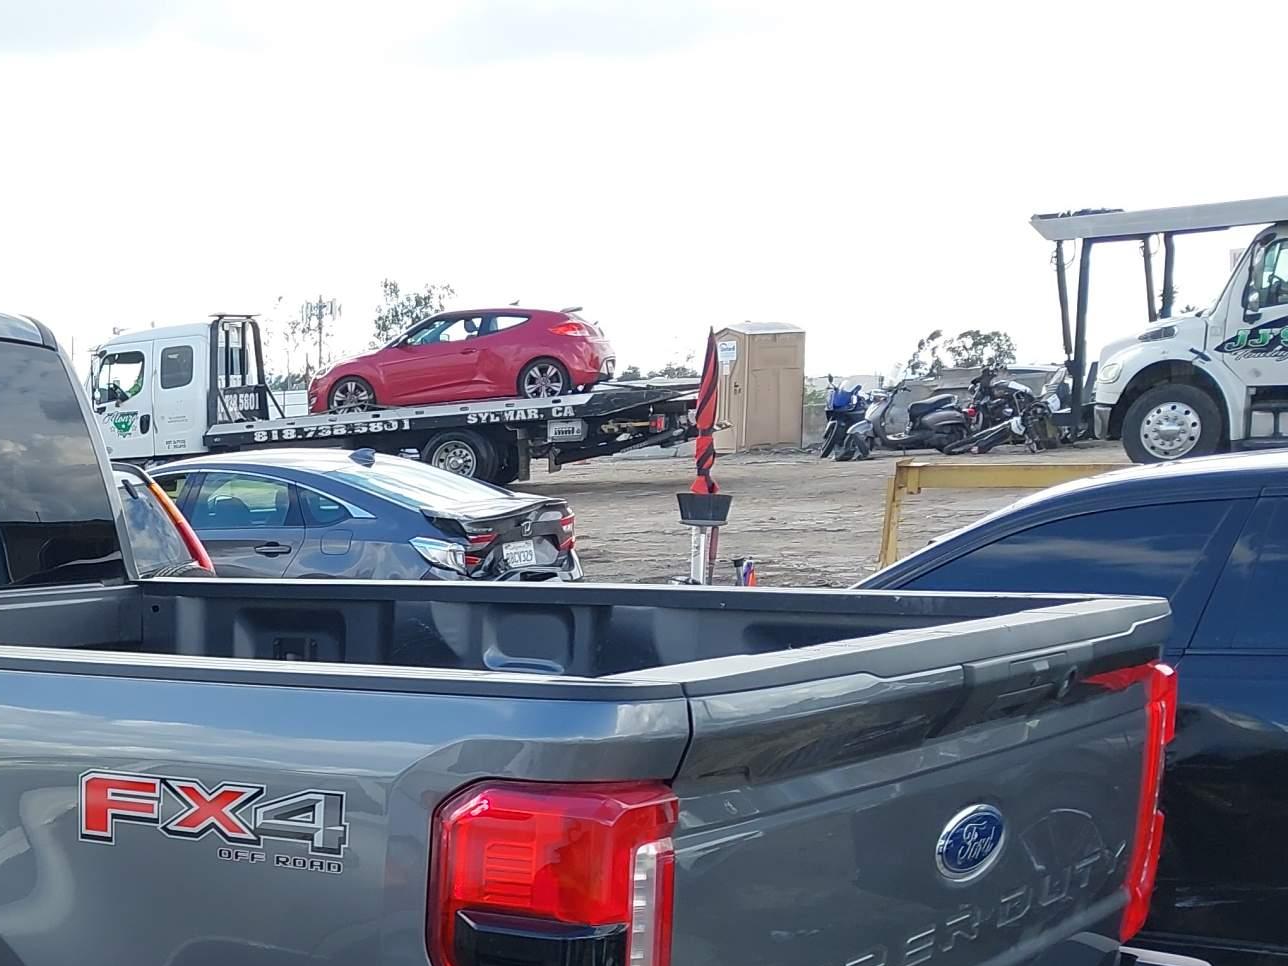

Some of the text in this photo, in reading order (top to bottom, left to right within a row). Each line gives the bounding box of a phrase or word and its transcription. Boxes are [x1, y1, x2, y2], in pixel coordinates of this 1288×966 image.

[551, 406, 576, 418] CA
[78, 768, 350, 858] FX4
[217, 846, 344, 874] OFF ROAD
[994, 838, 1129, 930] DUTY
